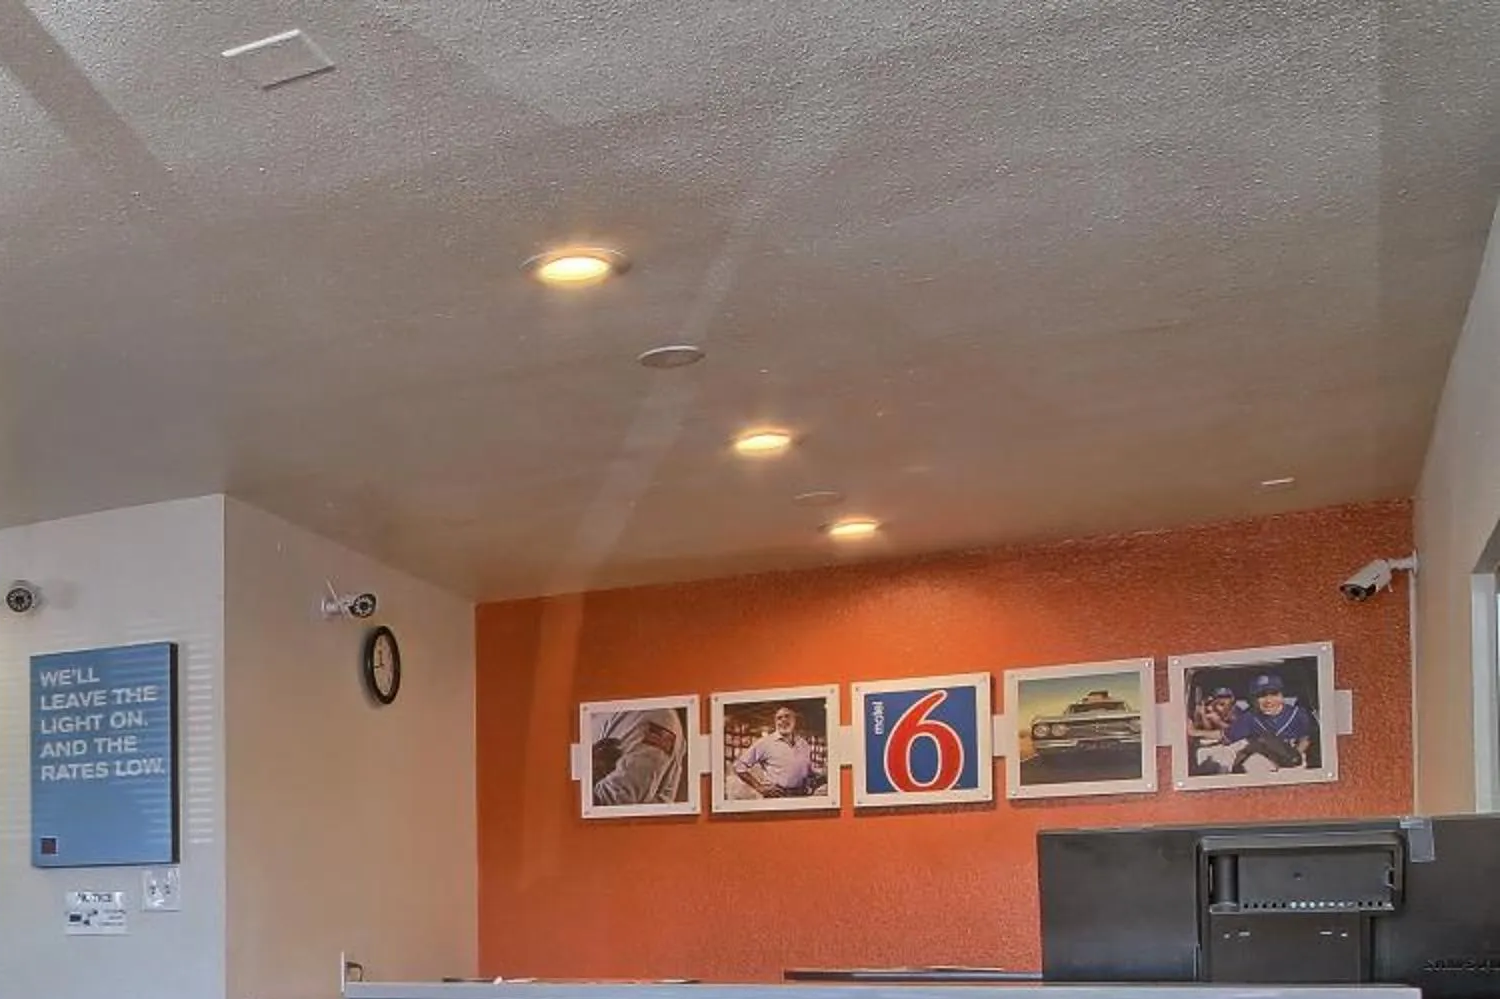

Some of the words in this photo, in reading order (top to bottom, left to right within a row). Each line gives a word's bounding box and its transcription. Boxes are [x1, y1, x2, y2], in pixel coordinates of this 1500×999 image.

[40, 668, 100, 688] WE'LL
[41, 689, 107, 711] LEAVE
[111, 685, 159, 705] THE
[41, 713, 103, 735] LIGHT
[110, 710, 149, 729] ON.
[40, 739, 88, 758] AND
[94, 735, 138, 754] THE
[883, 690, 964, 792] 6
[41, 761, 109, 781] RATES
[114, 757, 165, 777] LOW.
